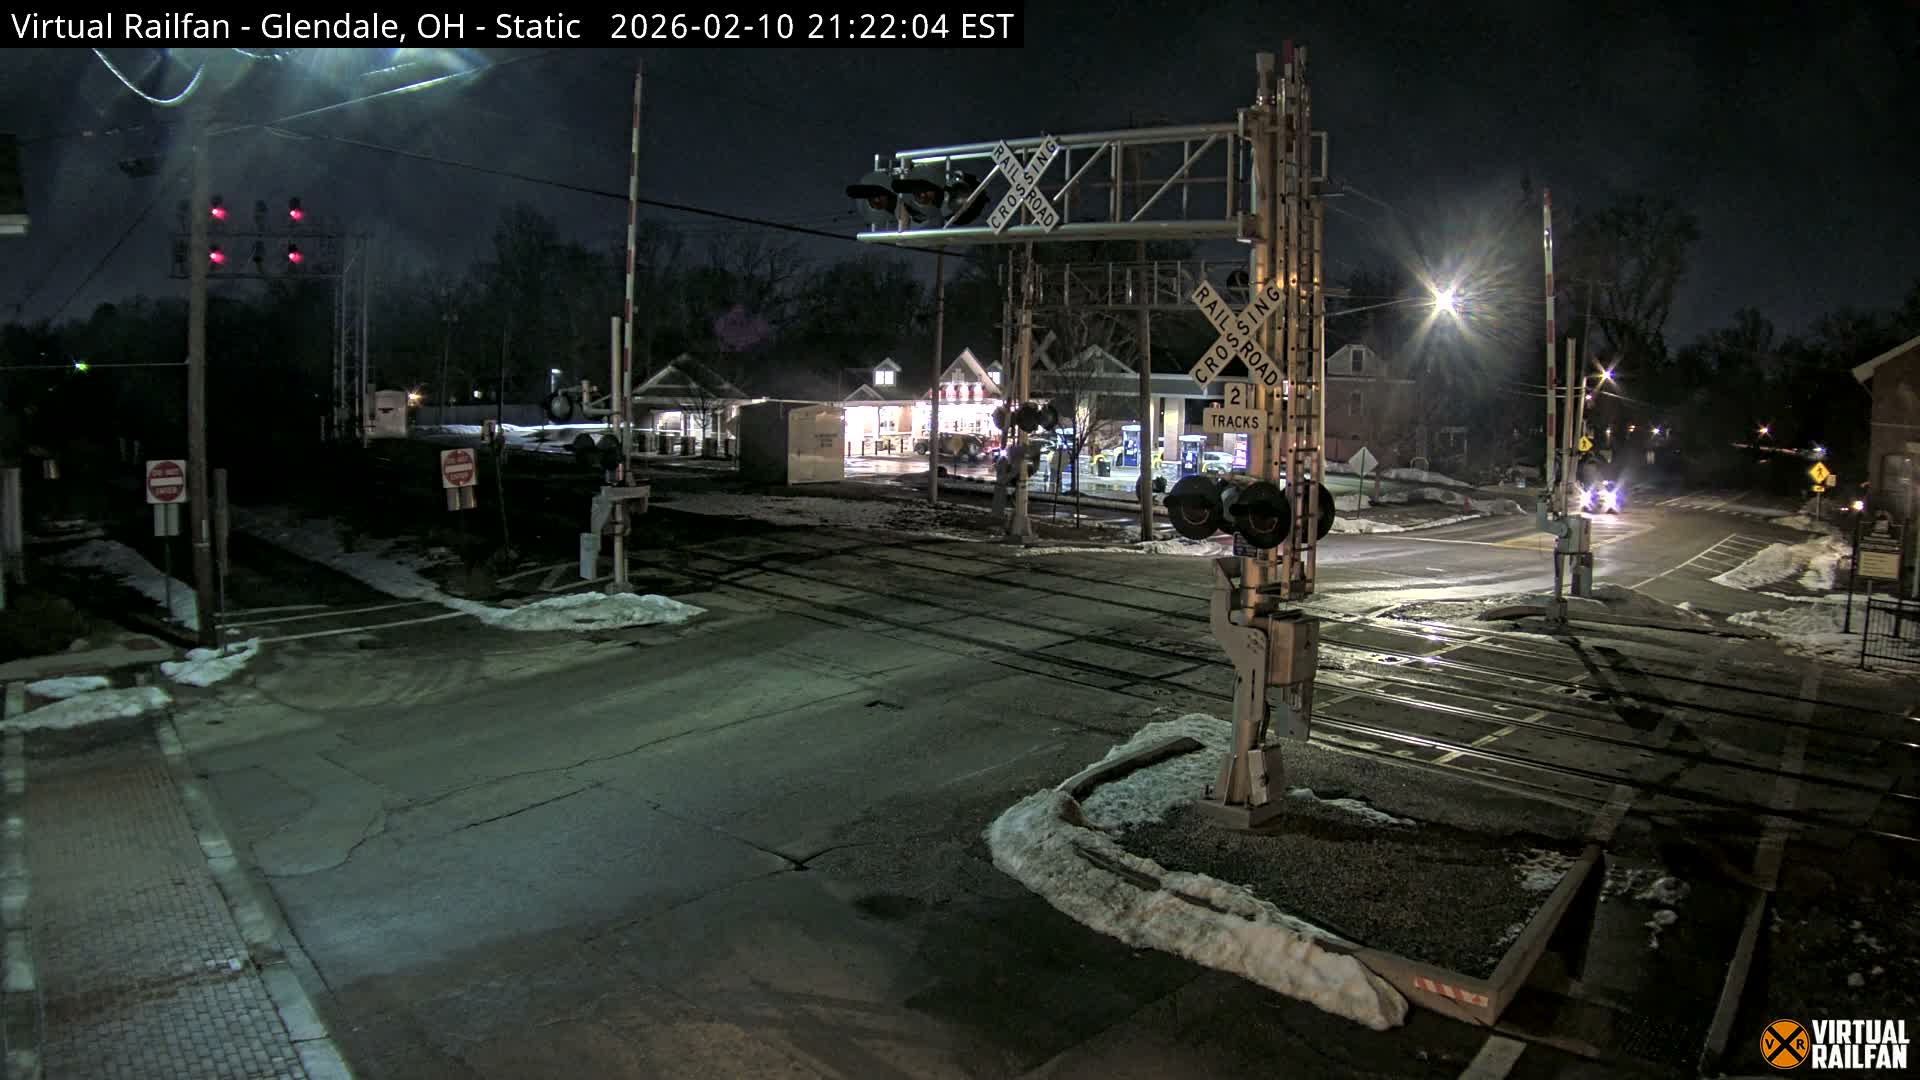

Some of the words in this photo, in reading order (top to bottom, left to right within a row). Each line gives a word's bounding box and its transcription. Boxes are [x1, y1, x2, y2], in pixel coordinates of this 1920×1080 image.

[991, 140, 1056, 229] CROSSING
[1195, 287, 1280, 384] CROSSING
[1211, 414, 1260, 429] TRACKS
[1230, 387, 1241, 405] 2
